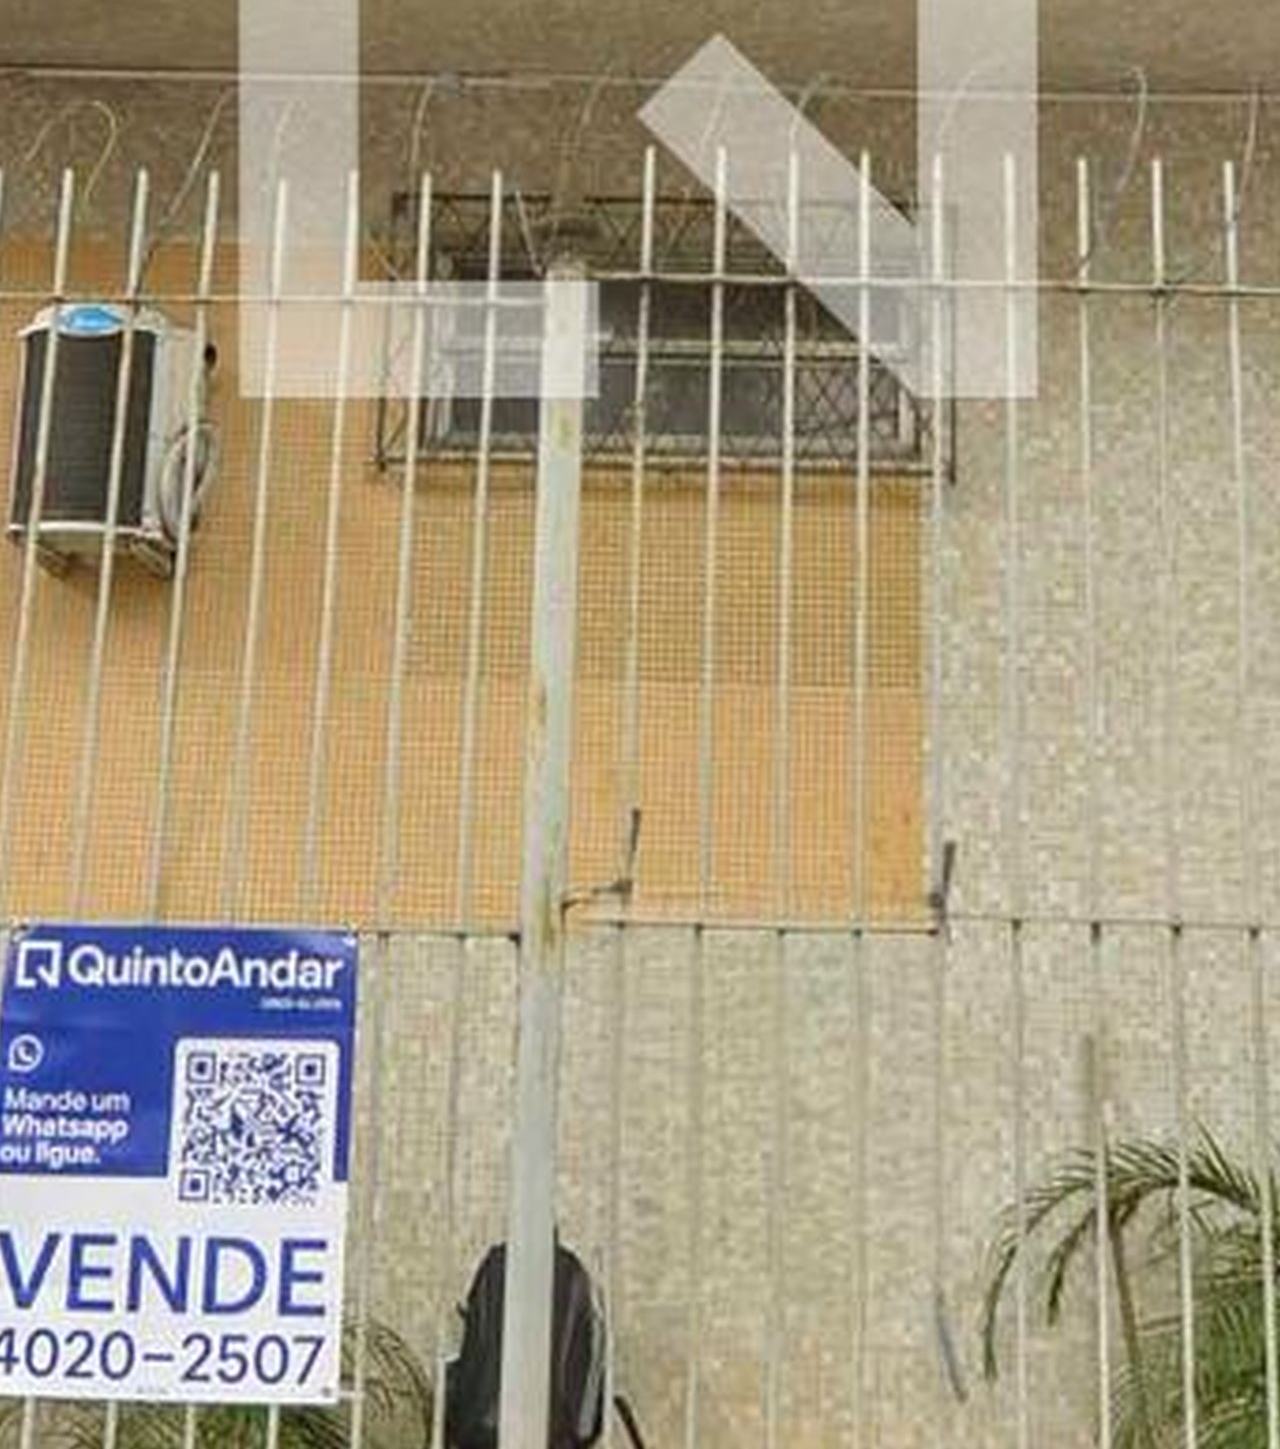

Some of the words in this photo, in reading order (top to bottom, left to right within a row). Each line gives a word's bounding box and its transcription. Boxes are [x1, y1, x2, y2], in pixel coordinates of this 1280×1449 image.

[68, 944, 345, 990] QuintoAndar
[4, 1085, 87, 1111] Mande
[91, 1089, 131, 1113] um
[1, 1112, 129, 1144] Whatsapp
[35, 1140, 101, 1169] ligue.
